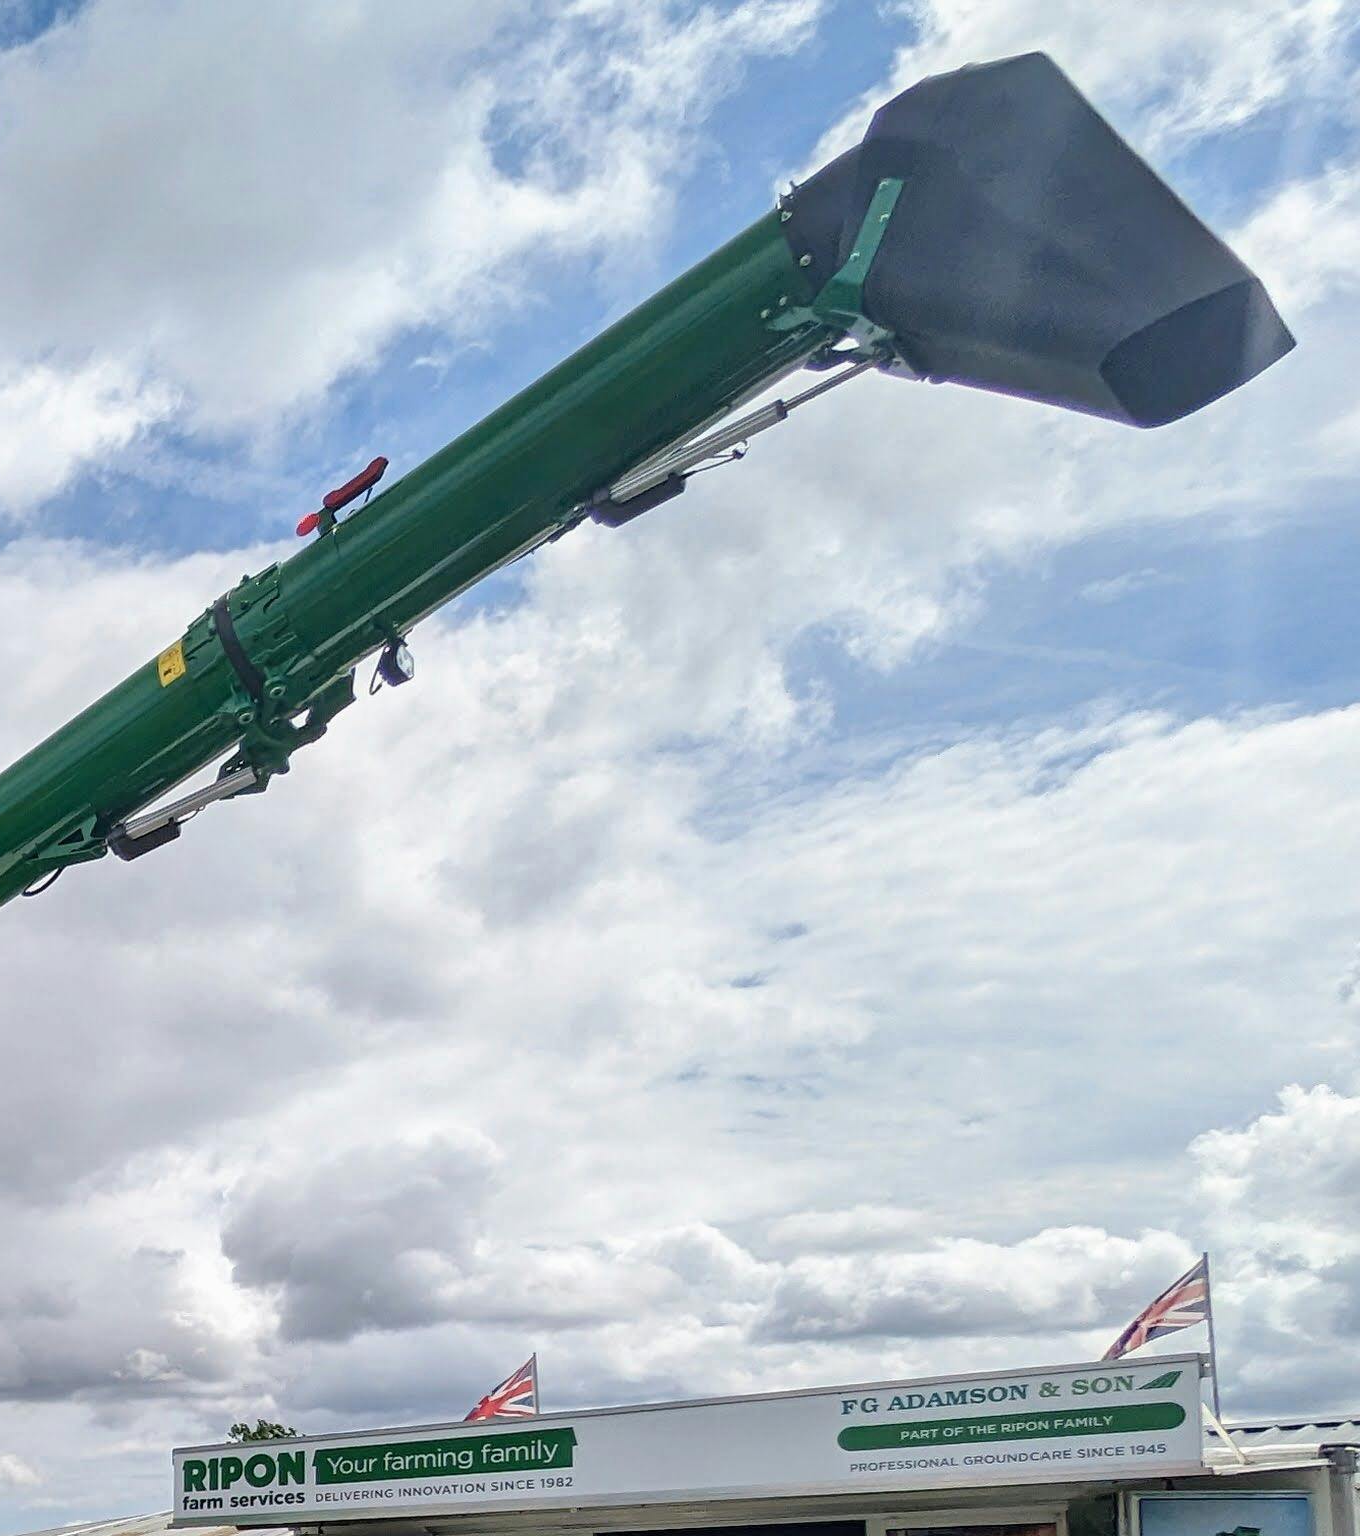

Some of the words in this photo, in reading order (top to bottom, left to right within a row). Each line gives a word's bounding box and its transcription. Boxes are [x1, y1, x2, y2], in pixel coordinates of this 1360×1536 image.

[841, 1398, 879, 1415] FG
[887, 1384, 1030, 1411] ADAMSON
[1039, 1382, 1061, 1398] &
[1072, 1375, 1135, 1396] SON
[901, 1427, 938, 1441] PART
[943, 1426, 964, 1438] OF
[968, 1423, 997, 1436] THE
[1001, 1419, 1049, 1433] RIPON
[1054, 1415, 1114, 1430] FAMILY
[182, 1449, 306, 1493] RIPON
[326, 1454, 378, 1475] Your
[383, 1443, 474, 1473] farming
[480, 1439, 559, 1466] family
[850, 1457, 959, 1473] PROFESSIONAL
[964, 1449, 1073, 1466] GROUNDCARE
[1077, 1446, 1125, 1459] SINCE
[1130, 1443, 1168, 1456] 1945
[182, 1496, 224, 1512] farm
[230, 1490, 306, 1508] services
[315, 1489, 394, 1503] DELIVERING
[398, 1482, 486, 1497] INNOVATION
[490, 1478, 535, 1492] SINCE
[540, 1476, 574, 1489] 1982
